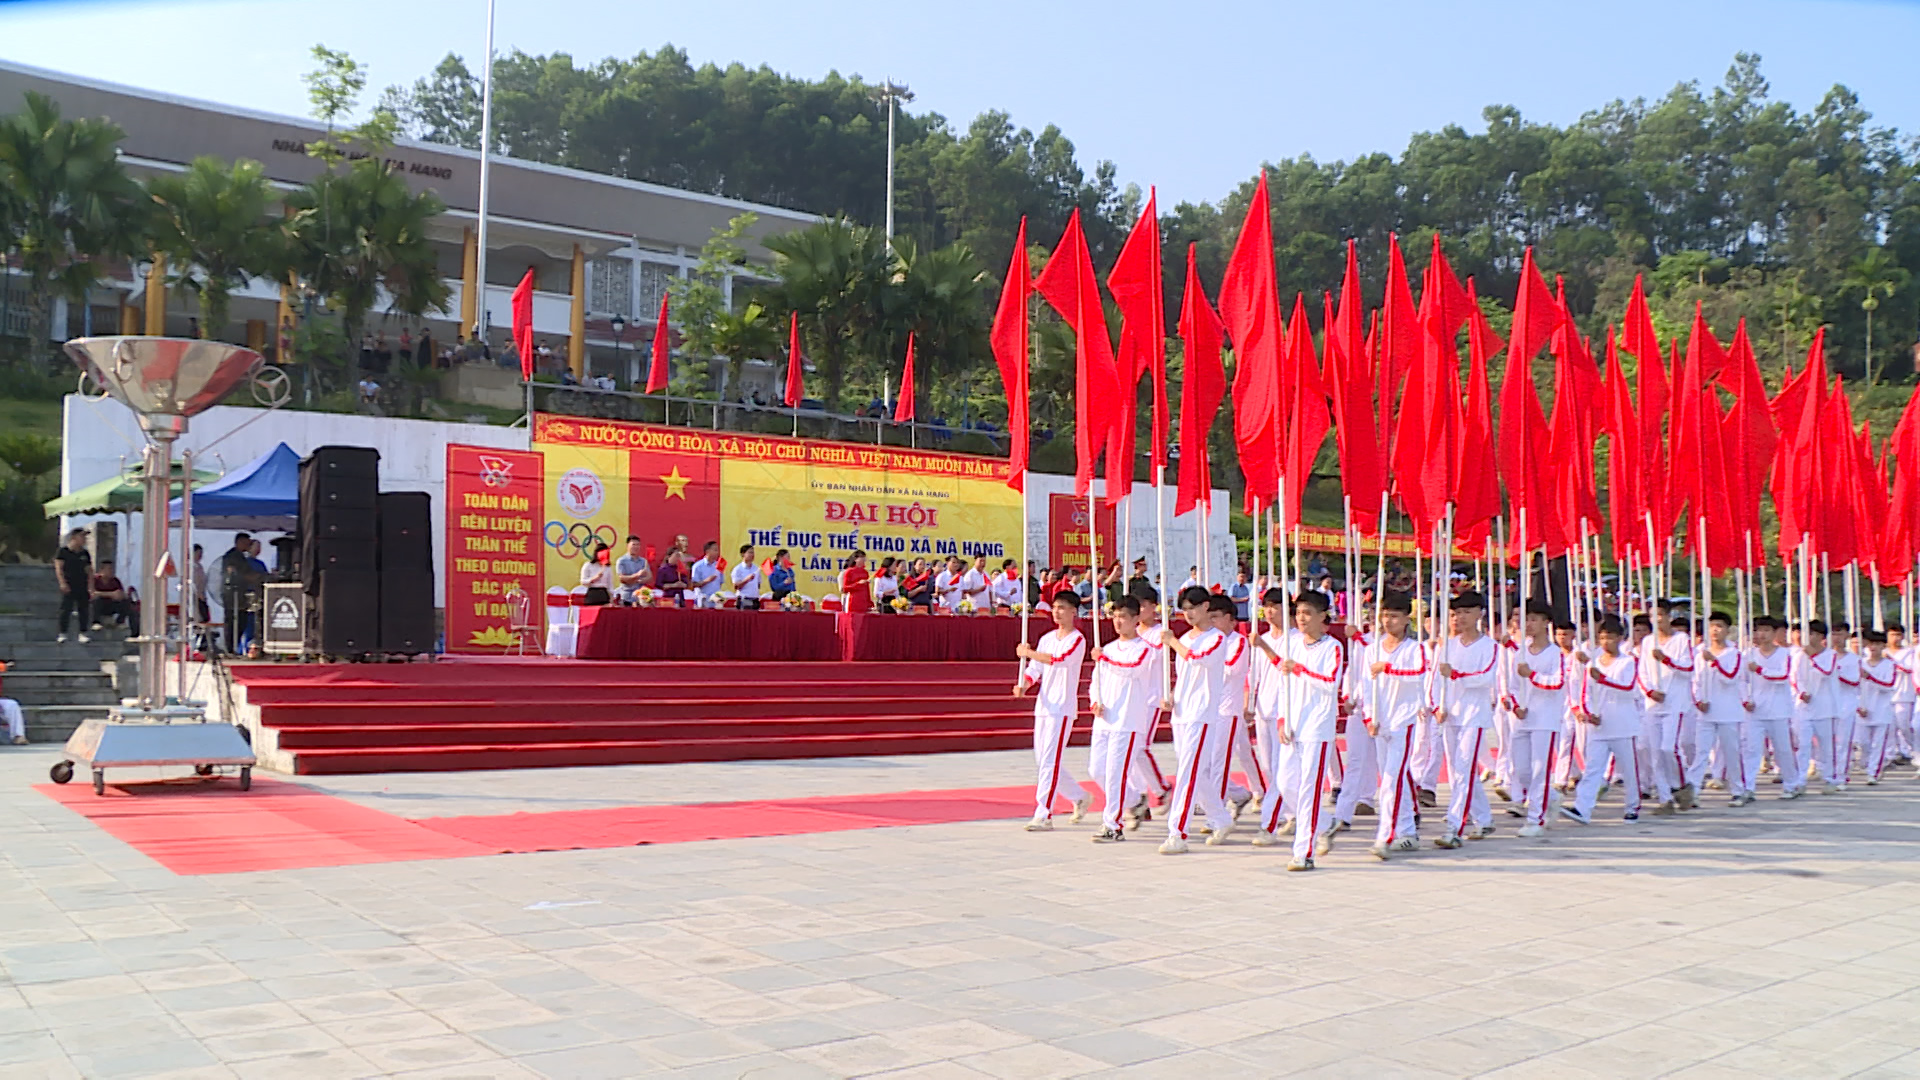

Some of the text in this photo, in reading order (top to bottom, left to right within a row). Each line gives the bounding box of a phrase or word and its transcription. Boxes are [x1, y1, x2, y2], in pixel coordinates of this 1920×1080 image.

[579, 423, 993, 475] NƯỚC CỘNG HÒA XÃ HỘI CHỦ NGHĨA VIỆT NAM MUÔN NĂM
[463, 492, 529, 512] TOÀN DÂN
[460, 512, 532, 535] RÈN LUYỆN
[824, 500, 938, 530] ĐẠI HỘI
[464, 535, 528, 554] THÂN THỂ
[748, 525, 1004, 557] THỂ DỤC THỂ THAO XÃ NÀ HANG
[1081, 533, 1104, 547] TO
[454, 557, 537, 576] THEO GƯƠNG
[472, 578, 500, 595] BÁC
